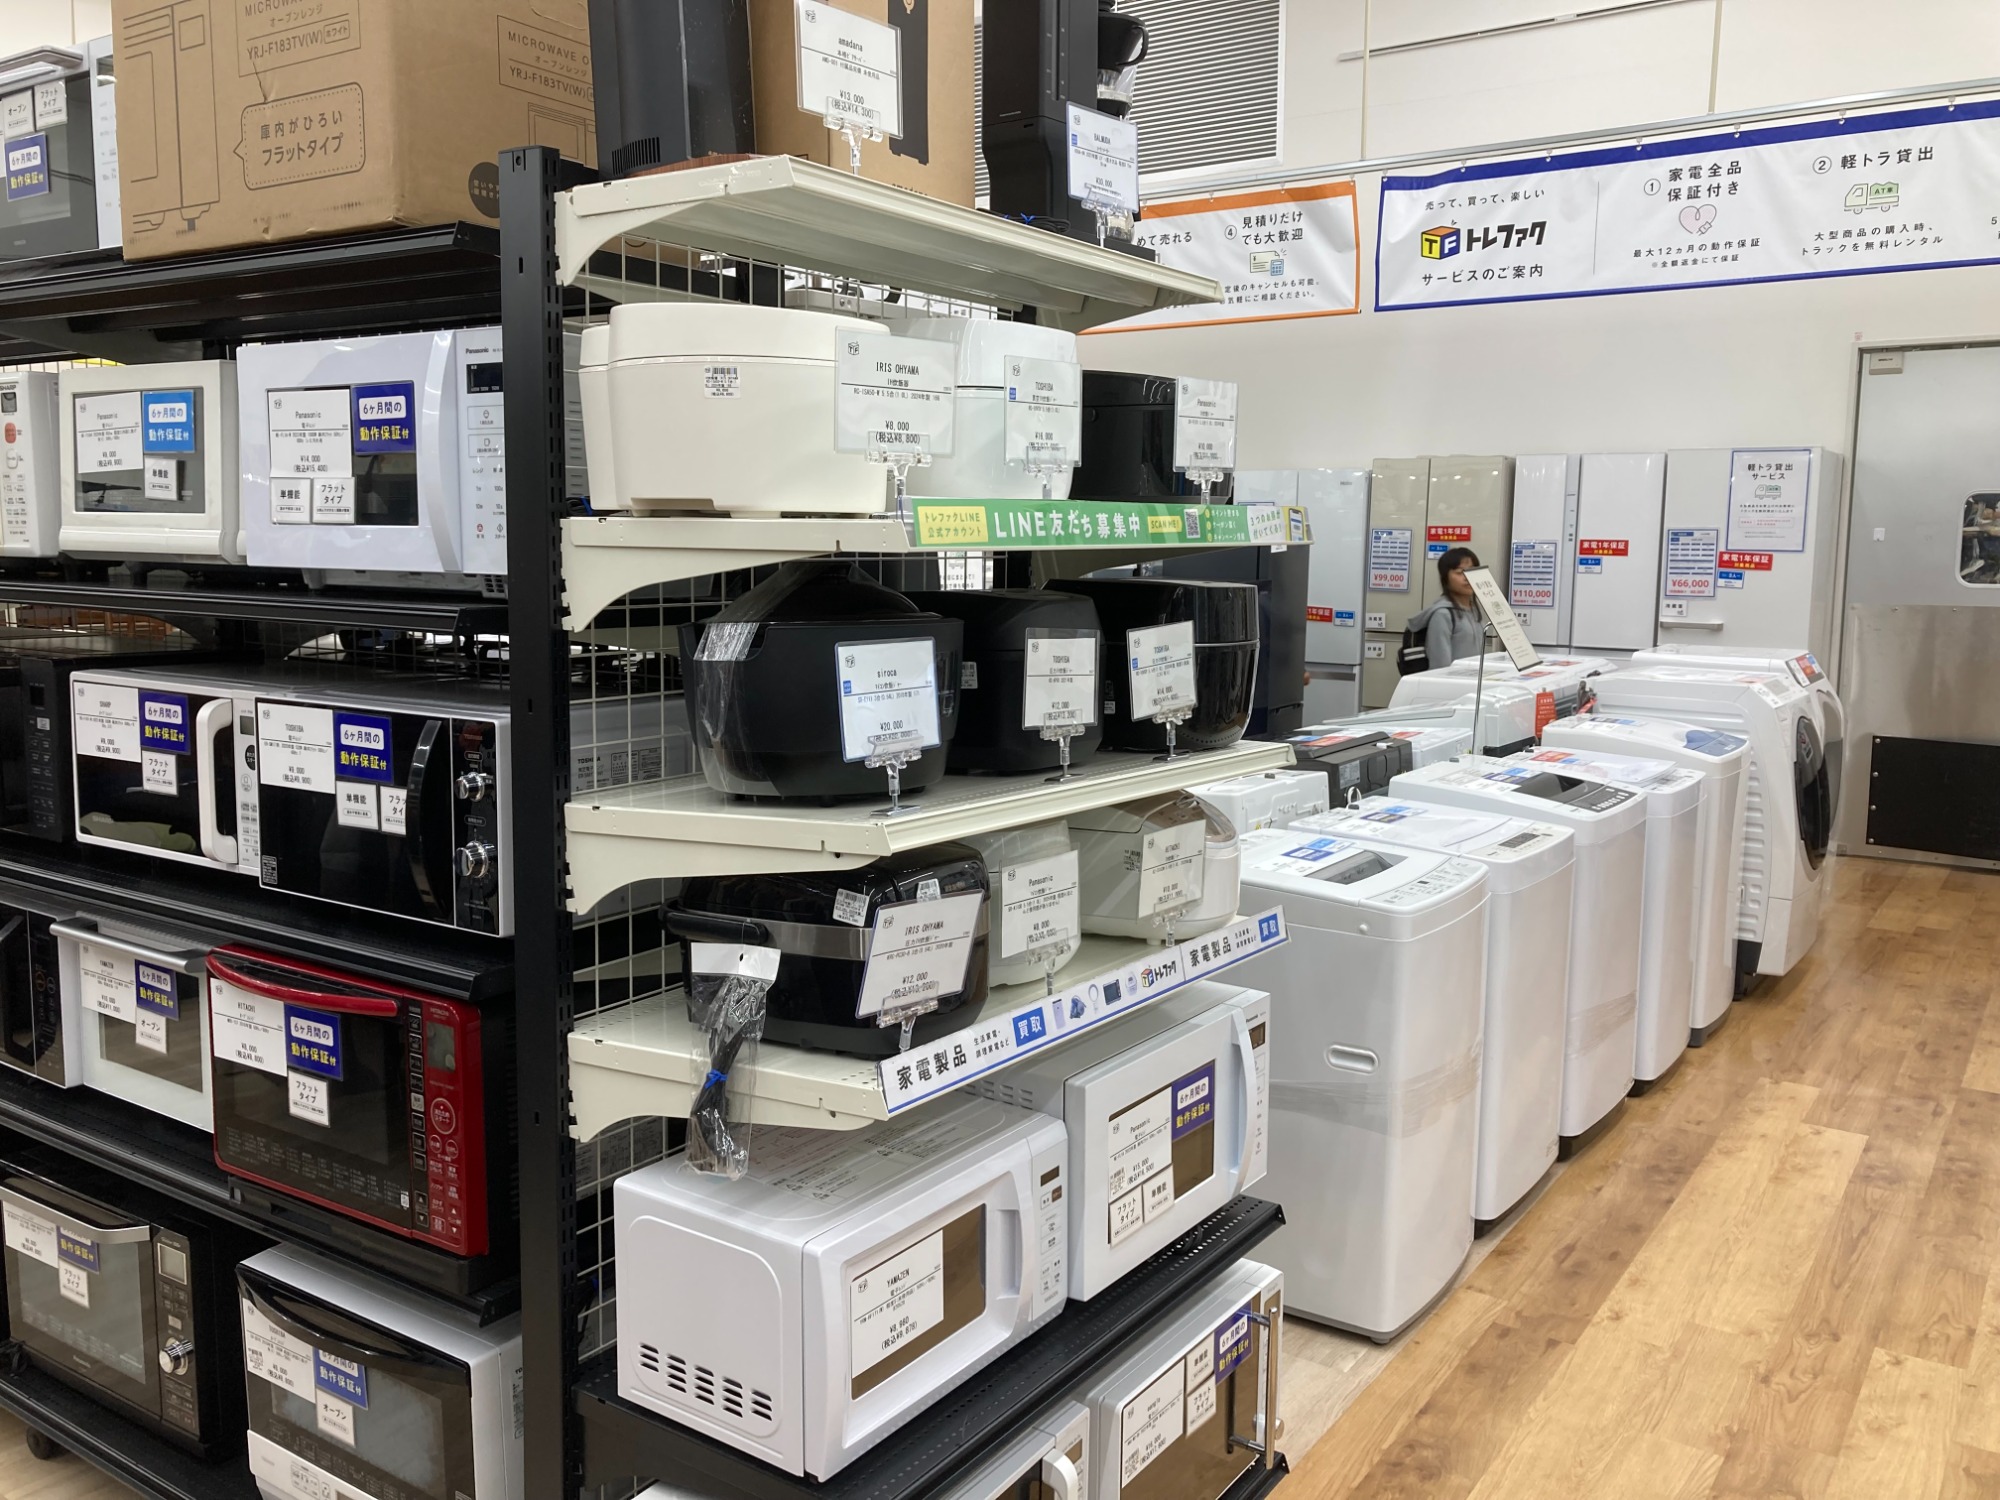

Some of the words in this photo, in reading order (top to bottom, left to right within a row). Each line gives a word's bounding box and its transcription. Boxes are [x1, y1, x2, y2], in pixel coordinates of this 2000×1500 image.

[269, 4, 323, 27] オープンレンジ
[246, 32, 323, 60] YRJ-F183TV(W)
[508, 31, 577, 61] MICROWAVE
[838, 37, 863, 52] amadana
[534, 55, 588, 77] オープンレンジ
[509, 66, 587, 97] YRJ-F183TV(W)
[40, 87, 58, 99] フラット
[840, 90, 864, 105] ¥13,000
[8, 103, 27, 116] オープン
[43, 97, 57, 108] タイプ
[260, 110, 343, 140] 庫内がひろい
[262, 133, 344, 167] フラットタイプ
[1840, 145, 1934, 170] 軽トラ貸出
[11, 151, 38, 166] 6ヶ月間の
[1668, 160, 1742, 183] 家電全品
[10, 172, 44, 190] 動作保証付
[1667, 181, 1739, 202] 保証付き
[1874, 186, 1893, 195] AT車
[1425, 189, 1545, 211] 売って、買って、楽しい
[1242, 211, 1303, 229] 見積りだけ
[1137, 231, 1193, 246] めて売れる
[1242, 228, 1303, 246] でも大歓迎
[1466, 221, 1547, 252] トレファク
[1814, 223, 1935, 242] 大型商品の購入時、
[1802, 236, 1943, 256] トラックを無料レンタル
[1422, 264, 1543, 286] サービスのご案内
[465, 347, 489, 355] Panasonic
[876, 362, 892, 373] IRIS
[895, 364, 919, 375] OHYAMA
[151, 407, 183, 418] 6ヶ月間の
[295, 411, 321, 419] Panasonic
[363, 402, 402, 415] 6ヶ月間の
[885, 420, 909, 431] ¥8,000
[148, 428, 189, 441] 動作保証付
[360, 426, 409, 442] 動作保証付
[875, 431, 920, 444] (税込¥8,800)
[300, 455, 321, 463] ¥14,000
[152, 469, 169, 479] 単機能
[1748, 463, 1793, 472] 軽トラ貸出
[1751, 472, 1786, 481] サービス
[280, 489, 301, 500] 単機能
[321, 484, 346, 494] フラット
[323, 495, 343, 504] タイプ
[924, 511, 981, 524] トレファクLINE
[994, 510, 1140, 538] LINE友だち募集中
[1151, 519, 1167, 529] SCAN
[926, 526, 982, 539] 公式アカウント
[1583, 541, 1625, 549] 家電1年保証
[1722, 554, 1769, 563] 家電1年保証
[1374, 573, 1404, 582] ¥99,000
[1671, 579, 1709, 589] ¥66,000
[1513, 590, 1551, 598] ¥110,000
[1154, 645, 1170, 653] TOSHIBA
[1053, 655, 1070, 663] TOSHIBA
[877, 669, 897, 678] siroca
[148, 706, 179, 719] 6ヶ月間の
[145, 725, 185, 742] 動作保証付
[285, 724, 304, 733] TOSHIBA
[880, 720, 904, 732] ¥20,000
[344, 729, 380, 744] 6ヶ月間の
[148, 758, 169, 767] フラット
[340, 752, 387, 771] 動作保証付
[151, 768, 167, 777] タイプ
[346, 793, 367, 805] 単機能
[392, 806, 404, 815] タイ
[1028, 875, 1053, 887] Panasonic
[905, 925, 920, 936] IRIS
[922, 921, 944, 933] OHYAMA
[1261, 920, 1277, 937] 買取
[1190, 937, 1231, 967] 家電製品
[142, 970, 168, 986] 6ヶ月間の
[902, 971, 929, 985] ¥12,000
[1154, 961, 1176, 981] トレファク
[139, 987, 173, 1008] 動作保証付
[238, 1002, 256, 1013] HITACHI
[141, 1019, 161, 1032] オープン
[293, 1022, 330, 1041] 6ヶ月間の
[1018, 1015, 1042, 1039] 買取
[291, 1042, 336, 1066] 動作保証付
[976, 1037, 1010, 1058] 調理家電など
[897, 1043, 968, 1091] 家電製品
[296, 1080, 319, 1093] フラット
[1180, 1082, 1207, 1104] 6ヶ月間の
[299, 1091, 316, 1103] タイプ
[1176, 1102, 1210, 1128] 動作保証付
[1130, 1118, 1151, 1134] Panasonic
[1151, 1182, 1167, 1198] 単機能
[1117, 1197, 1136, 1215] フラット
[1120, 1209, 1136, 1224] タイプ
[60, 1238, 95, 1262] 動作保証付
[886, 1268, 910, 1288] YAMAZEN
[889, 1315, 910, 1334] ¥8,980
[881, 1321, 918, 1350] (税込¥9,878)
[1222, 1323, 1246, 1348] 6ヶ月間の
[1219, 1339, 1249, 1372] 動作保証付
[320, 1366, 362, 1396] 動作保証付
[1193, 1386, 1211, 1406] フラット
[1196, 1396, 1210, 1411] タイプ
[323, 1404, 346, 1420] オープン
